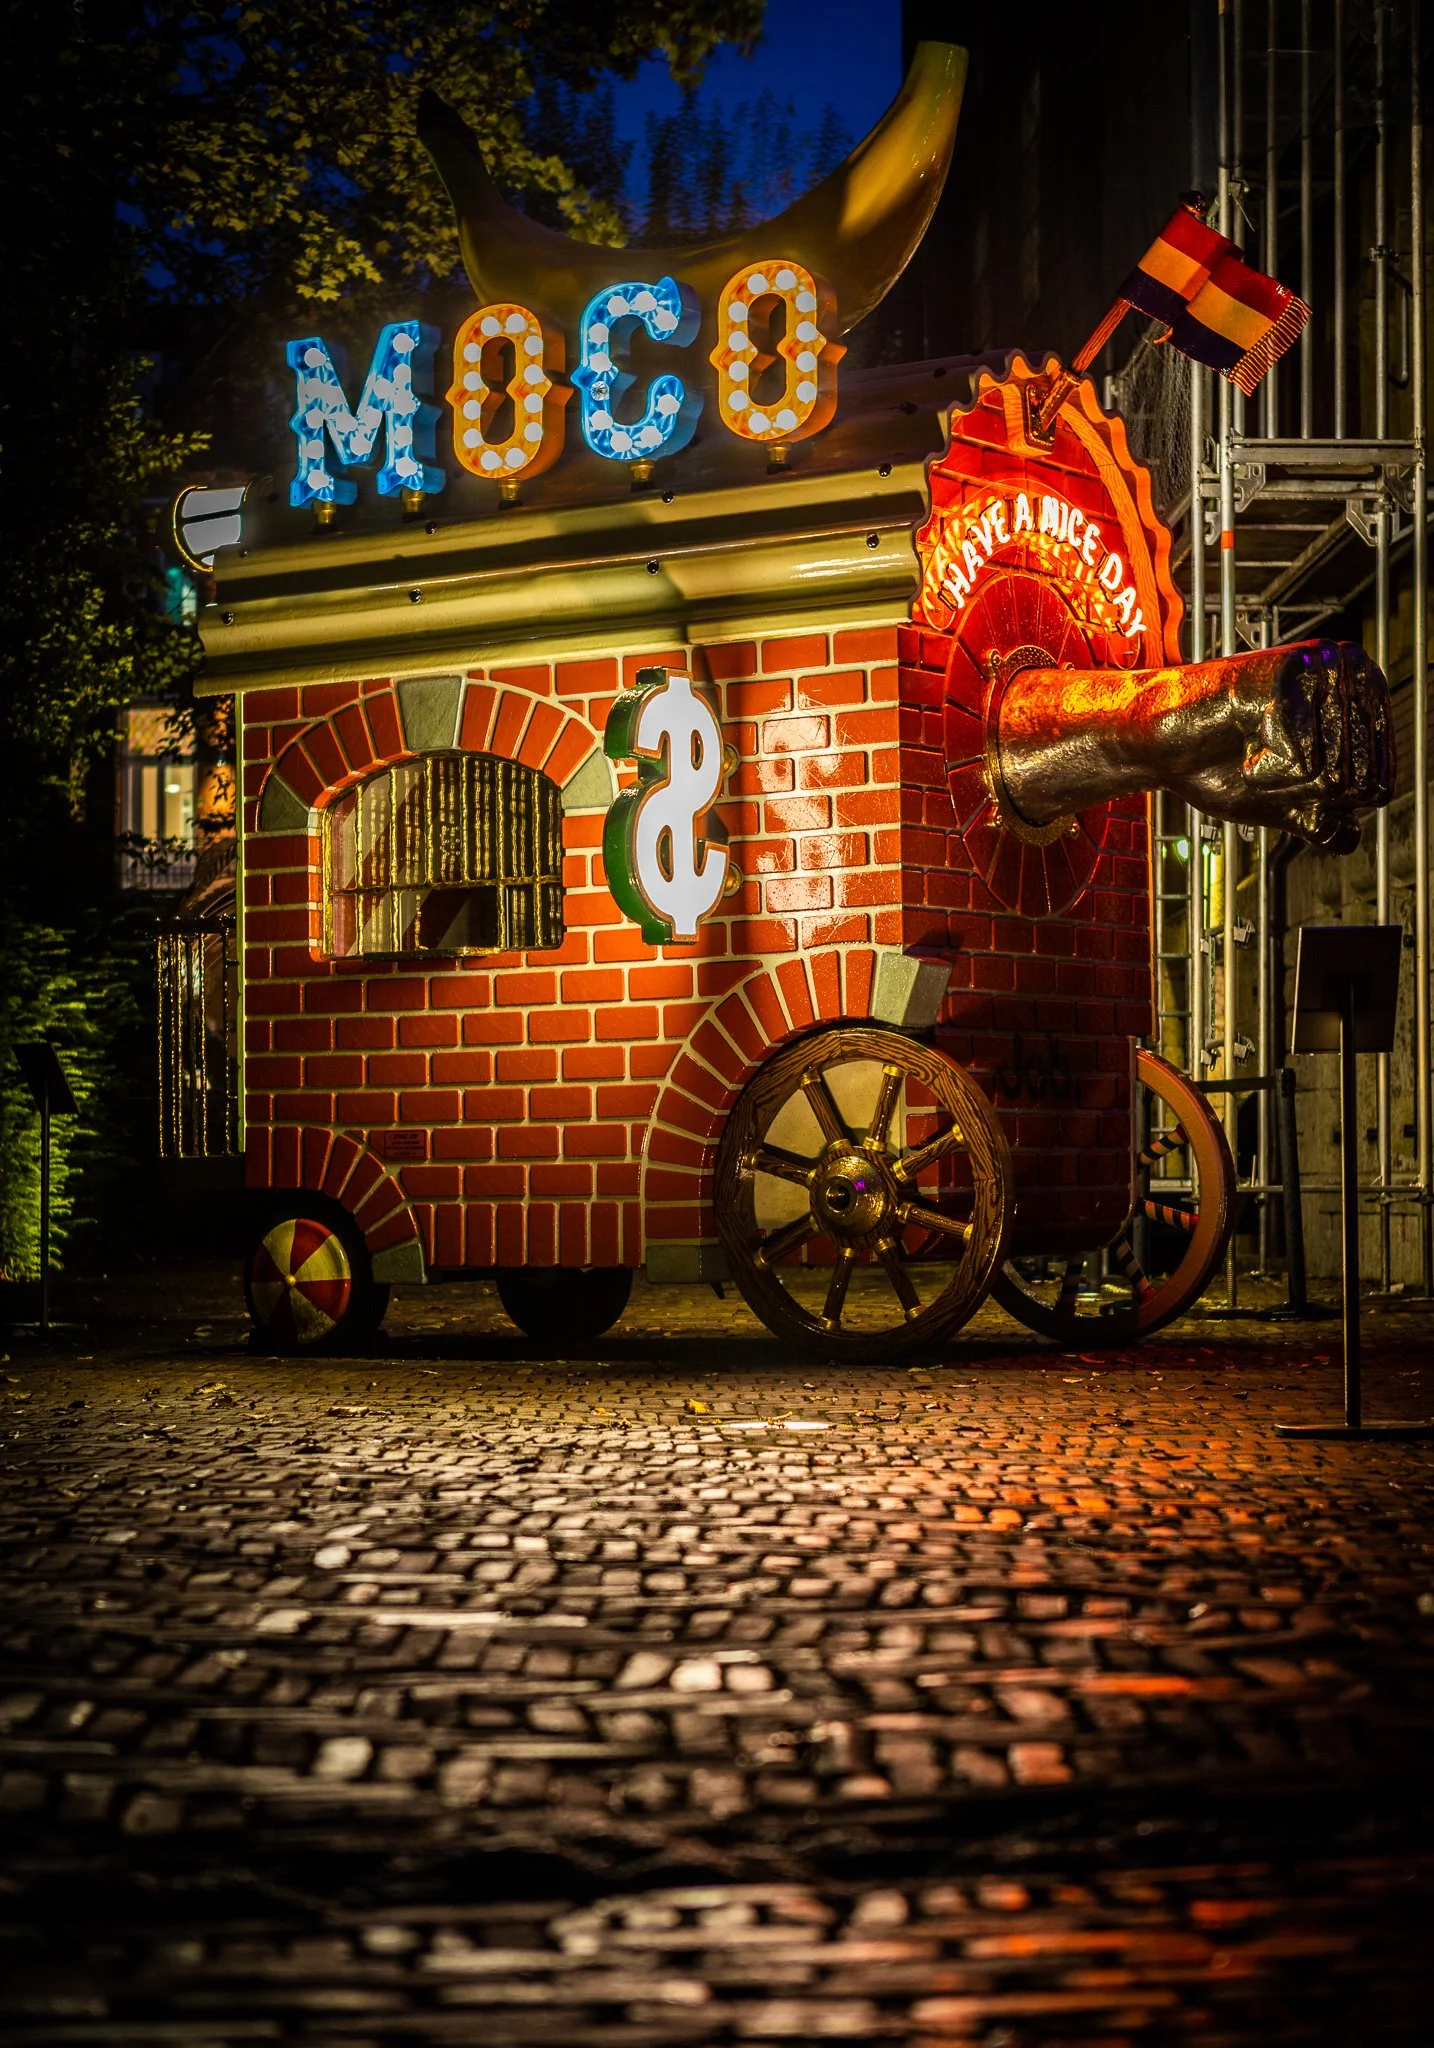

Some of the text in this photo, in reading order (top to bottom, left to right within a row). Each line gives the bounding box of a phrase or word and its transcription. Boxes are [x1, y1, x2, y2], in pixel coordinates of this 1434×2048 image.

[286, 260, 828, 507] MOCO
[942, 492, 1147, 638] HAVE A NICE DAY
